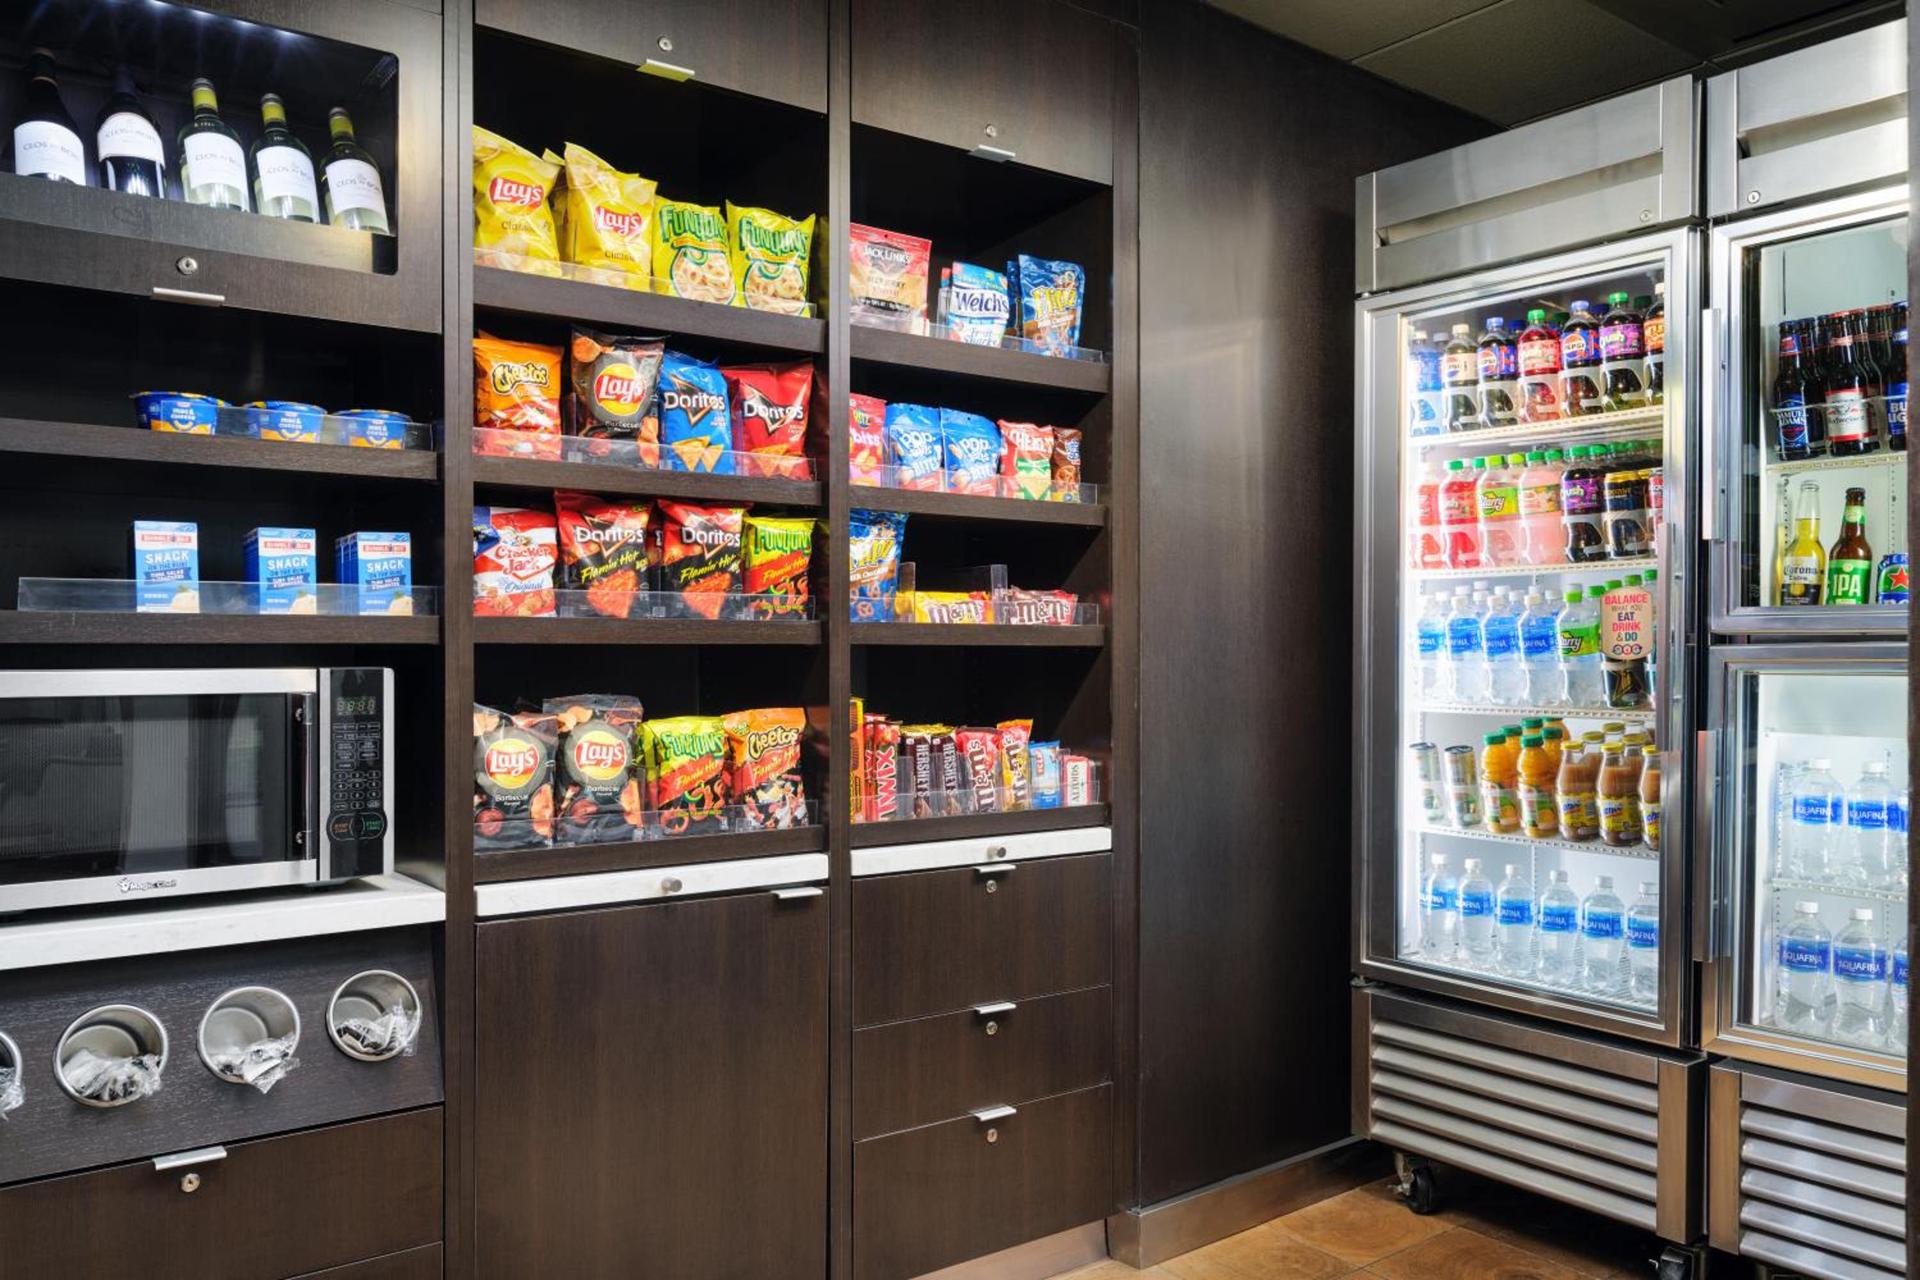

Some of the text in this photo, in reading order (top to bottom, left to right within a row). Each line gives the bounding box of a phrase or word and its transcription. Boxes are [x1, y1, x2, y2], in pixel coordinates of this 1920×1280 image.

[493, 178, 543, 205] Lay's
[597, 206, 642, 237] Lay's
[956, 291, 1010, 313] Welch's
[492, 363, 549, 393] Cheetos
[663, 392, 726, 411] Doritos
[742, 399, 804, 420] Doritos
[1890, 401, 1908, 413] BU
[1887, 411, 1908, 423] LIG
[575, 526, 644, 545] Doritos
[682, 527, 741, 547] Doritos
[144, 550, 190, 564] SNACK
[267, 557, 309, 570] SNACK
[367, 560, 405, 573] SNACK
[619, 551, 641, 567] Hot
[1833, 574, 1862, 597] IPA
[1604, 593, 1648, 605] BALANCE
[1618, 611, 1635, 621] EAT
[1612, 622, 1641, 632] DRINK
[1624, 631, 1638, 641] DO
[748, 726, 799, 760] Cheetos
[490, 750, 535, 775] Lay's
[580, 741, 623, 767] Lay's
[876, 746, 898, 818] WIX
[1782, 950, 1824, 965] AQUAFINA
[1838, 959, 1880, 974] AQUAFINA
